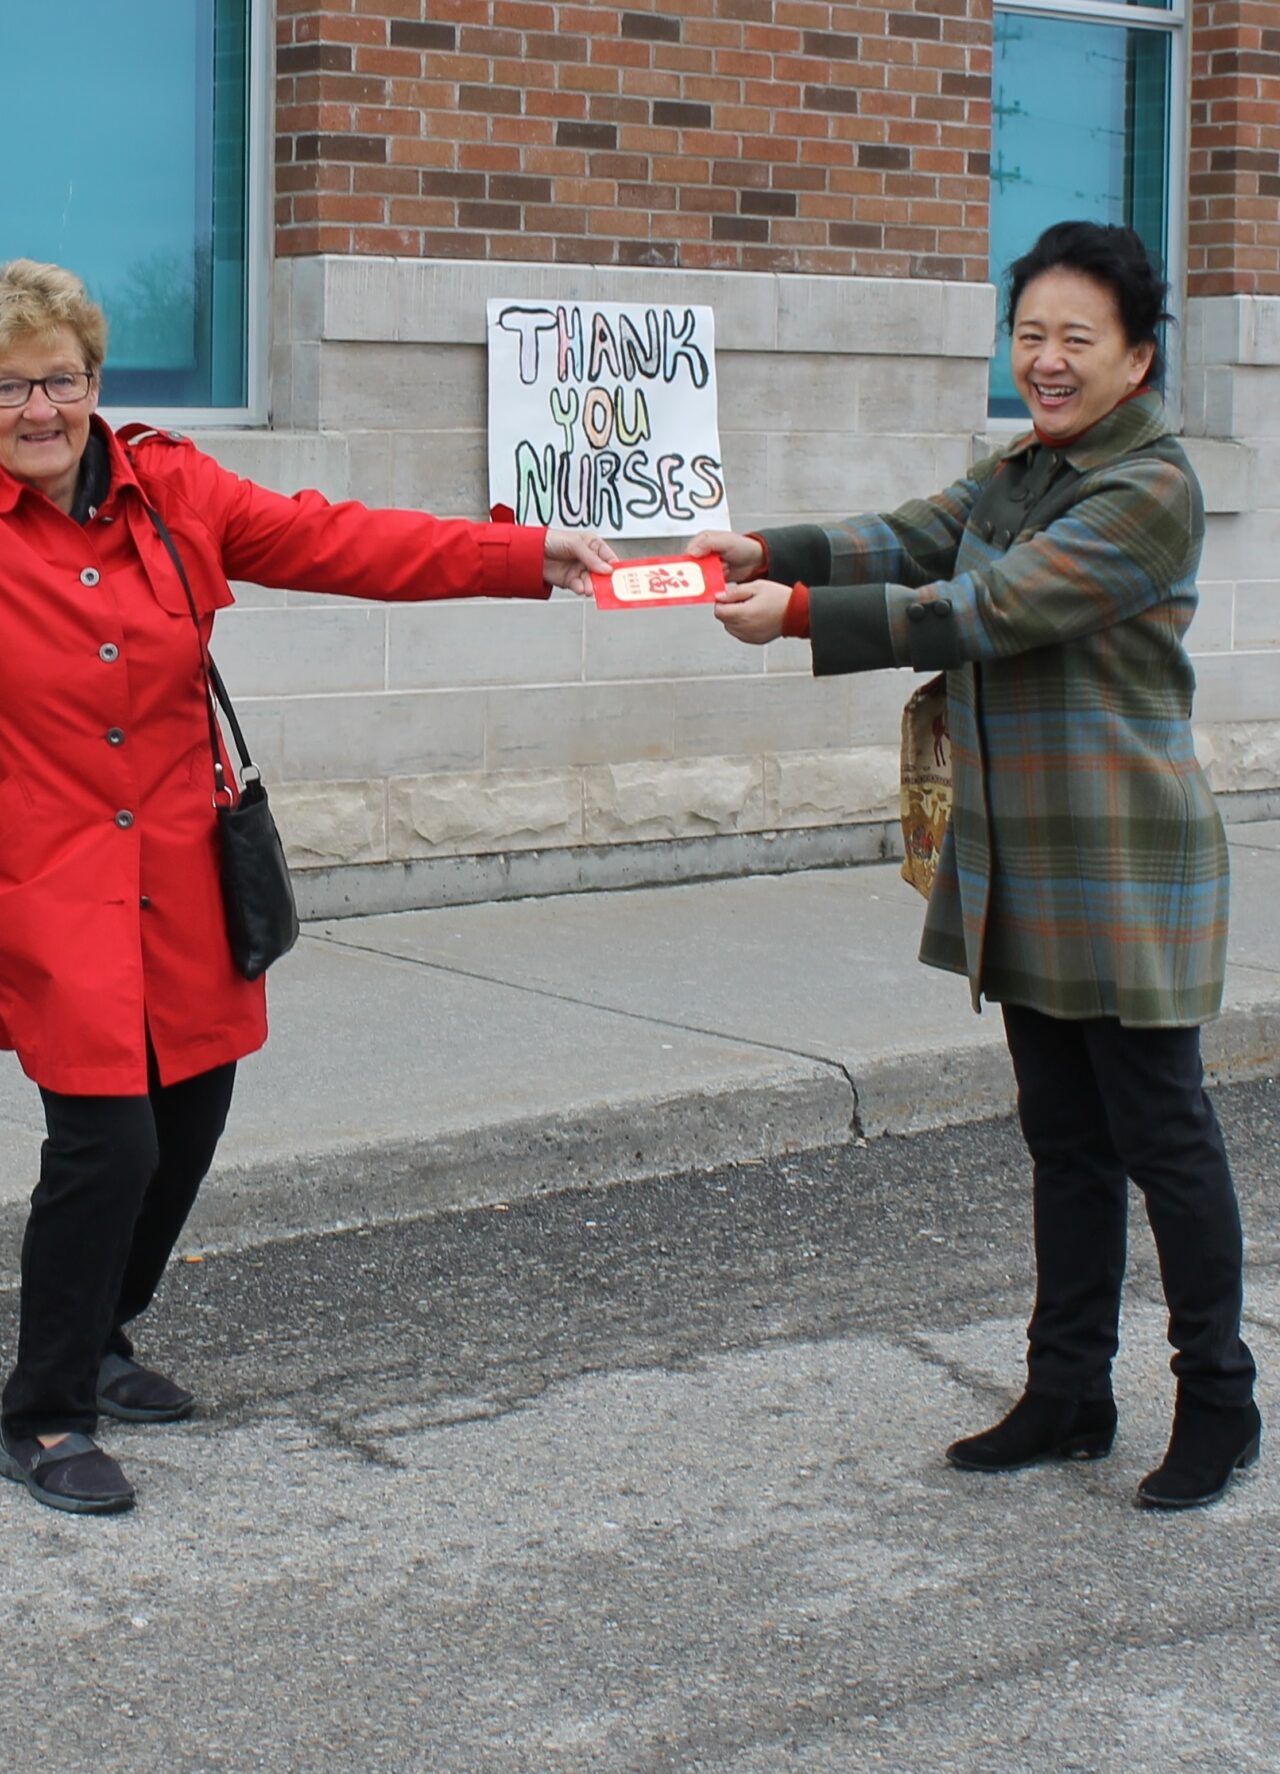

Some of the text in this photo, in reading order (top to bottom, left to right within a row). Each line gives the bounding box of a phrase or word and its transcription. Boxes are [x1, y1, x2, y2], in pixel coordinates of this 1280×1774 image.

[497, 306, 709, 389] THANK
[550, 385, 651, 455] YOU
[515, 440, 724, 531] NURSES
